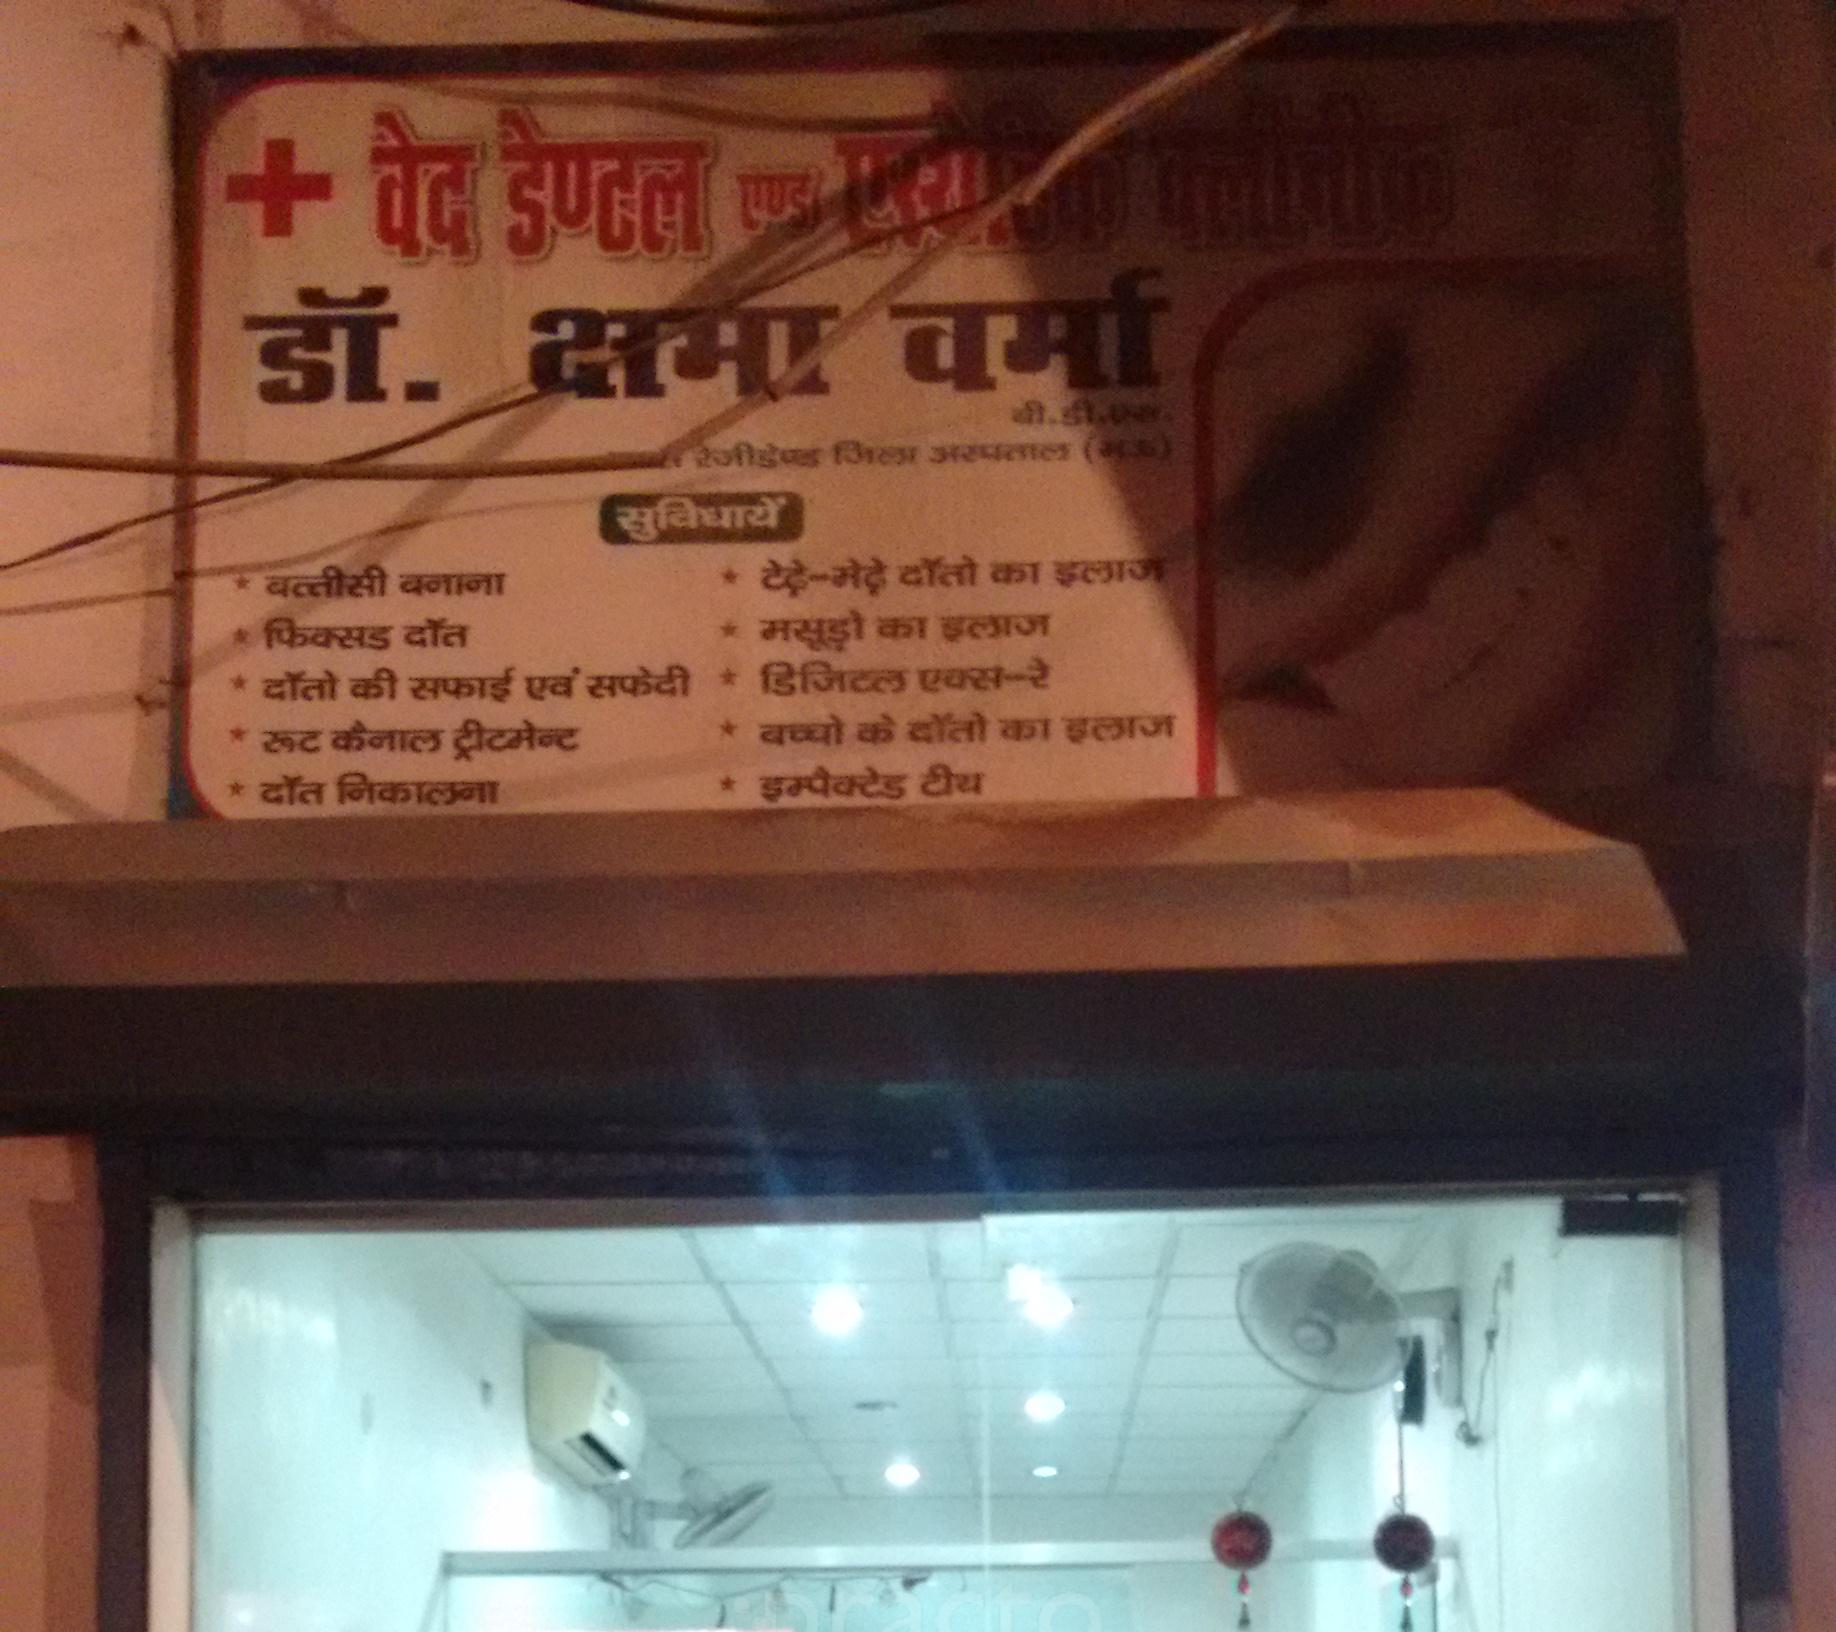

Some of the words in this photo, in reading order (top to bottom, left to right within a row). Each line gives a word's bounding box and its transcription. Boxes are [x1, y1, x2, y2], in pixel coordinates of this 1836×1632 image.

[369, 110, 480, 260] वेद
[498, 107, 711, 260] डेण्टल
[242, 285, 440, 403] डॉ.
[528, 303, 842, 401] क्षमा
[888, 266, 1172, 393] वर्मा
[929, 441, 1070, 466] अस्पताल
[400, 572, 507, 598] बनाना
[989, 560, 1042, 586] का
[1053, 557, 1167, 589] इलाज
[876, 614, 928, 641] का
[940, 613, 1052, 643] इलाज
[349, 666, 399, 701] की
[409, 666, 516, 703] सफाई
[524, 666, 581, 702] एवं
[585, 662, 693, 700] सफेदी
[760, 660, 911, 697] डिजिटल
[262, 728, 323, 754] रूट
[330, 718, 446, 754] कैनाल
[856, 712, 896, 746] के
[998, 717, 1052, 744] का
[1061, 713, 1176, 745] इलाज
[336, 771, 501, 807] निकालना
[920, 762, 985, 798] टीथ
